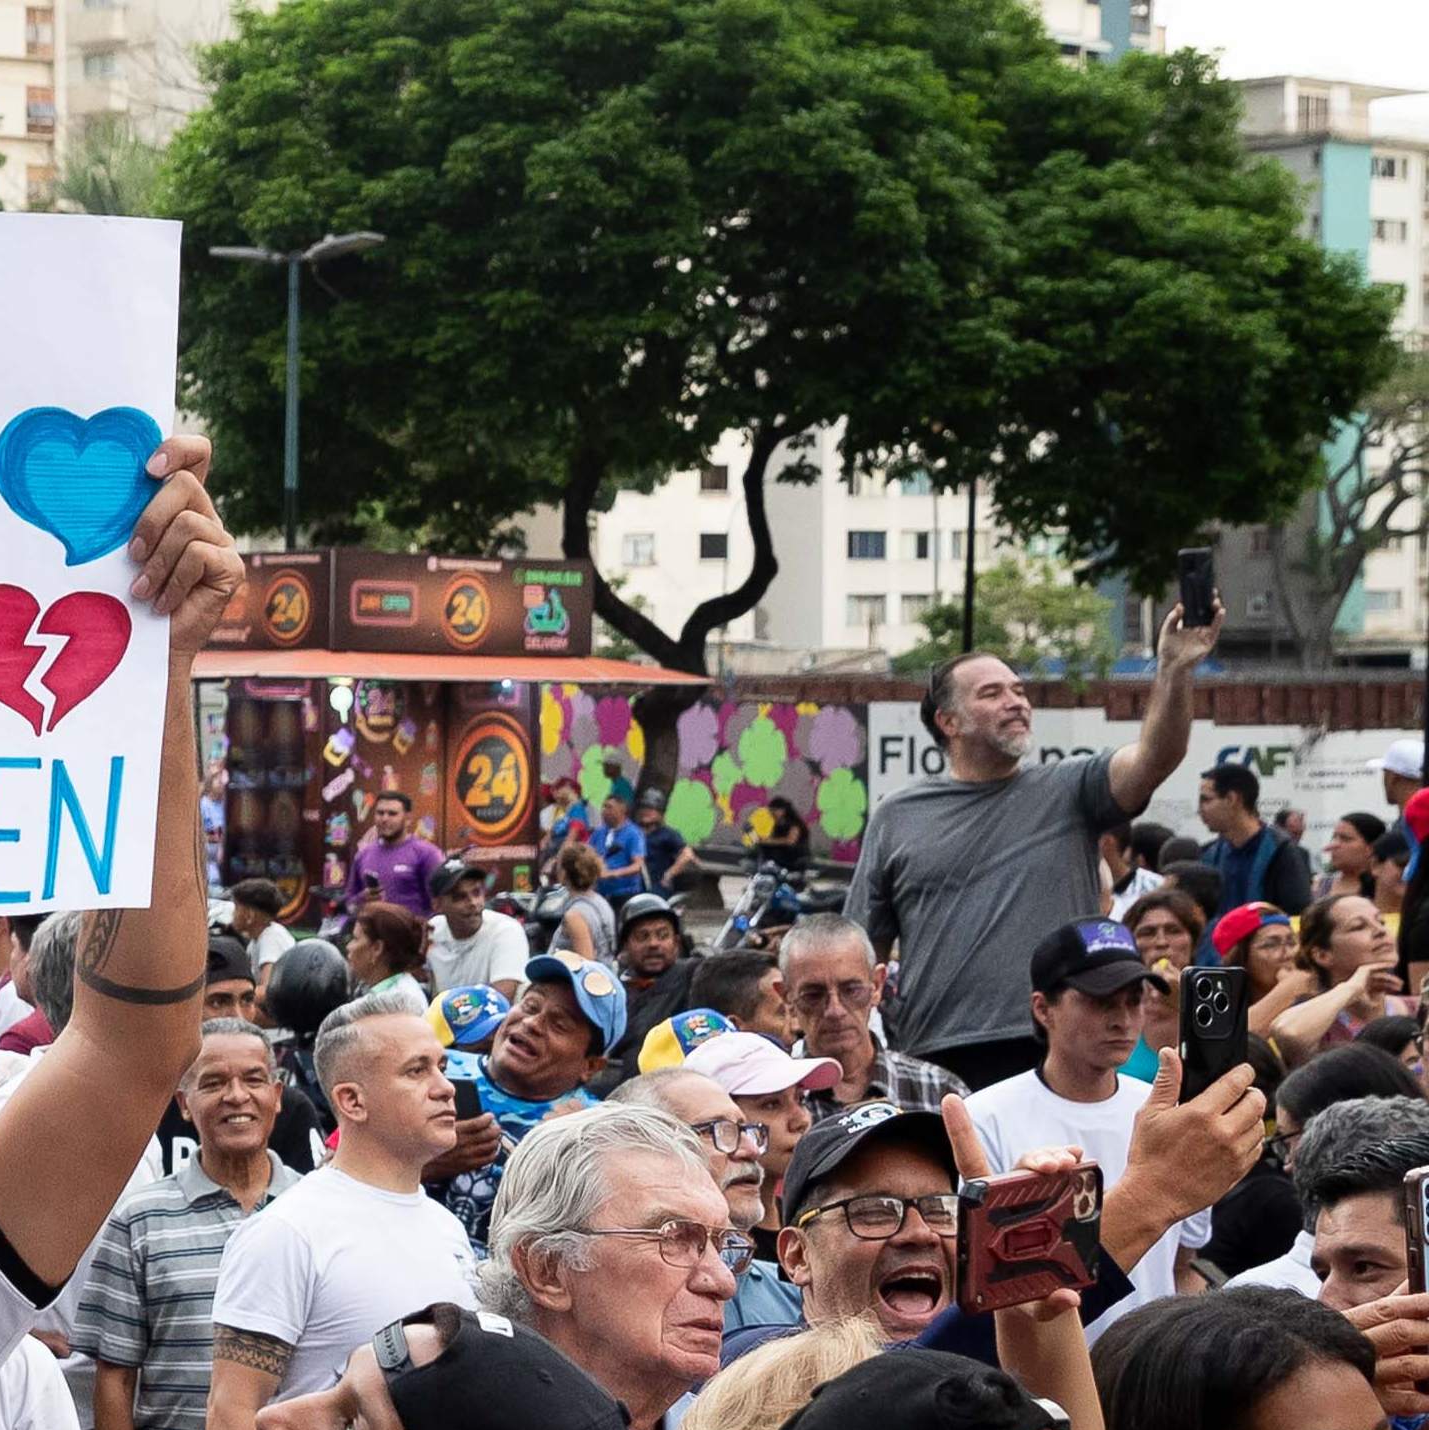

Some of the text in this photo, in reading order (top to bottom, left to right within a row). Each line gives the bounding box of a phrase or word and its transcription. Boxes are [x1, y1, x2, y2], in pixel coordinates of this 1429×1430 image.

[270, 591, 305, 625] 24
[449, 592, 483, 626] 24
[466, 752, 518, 807] 24
